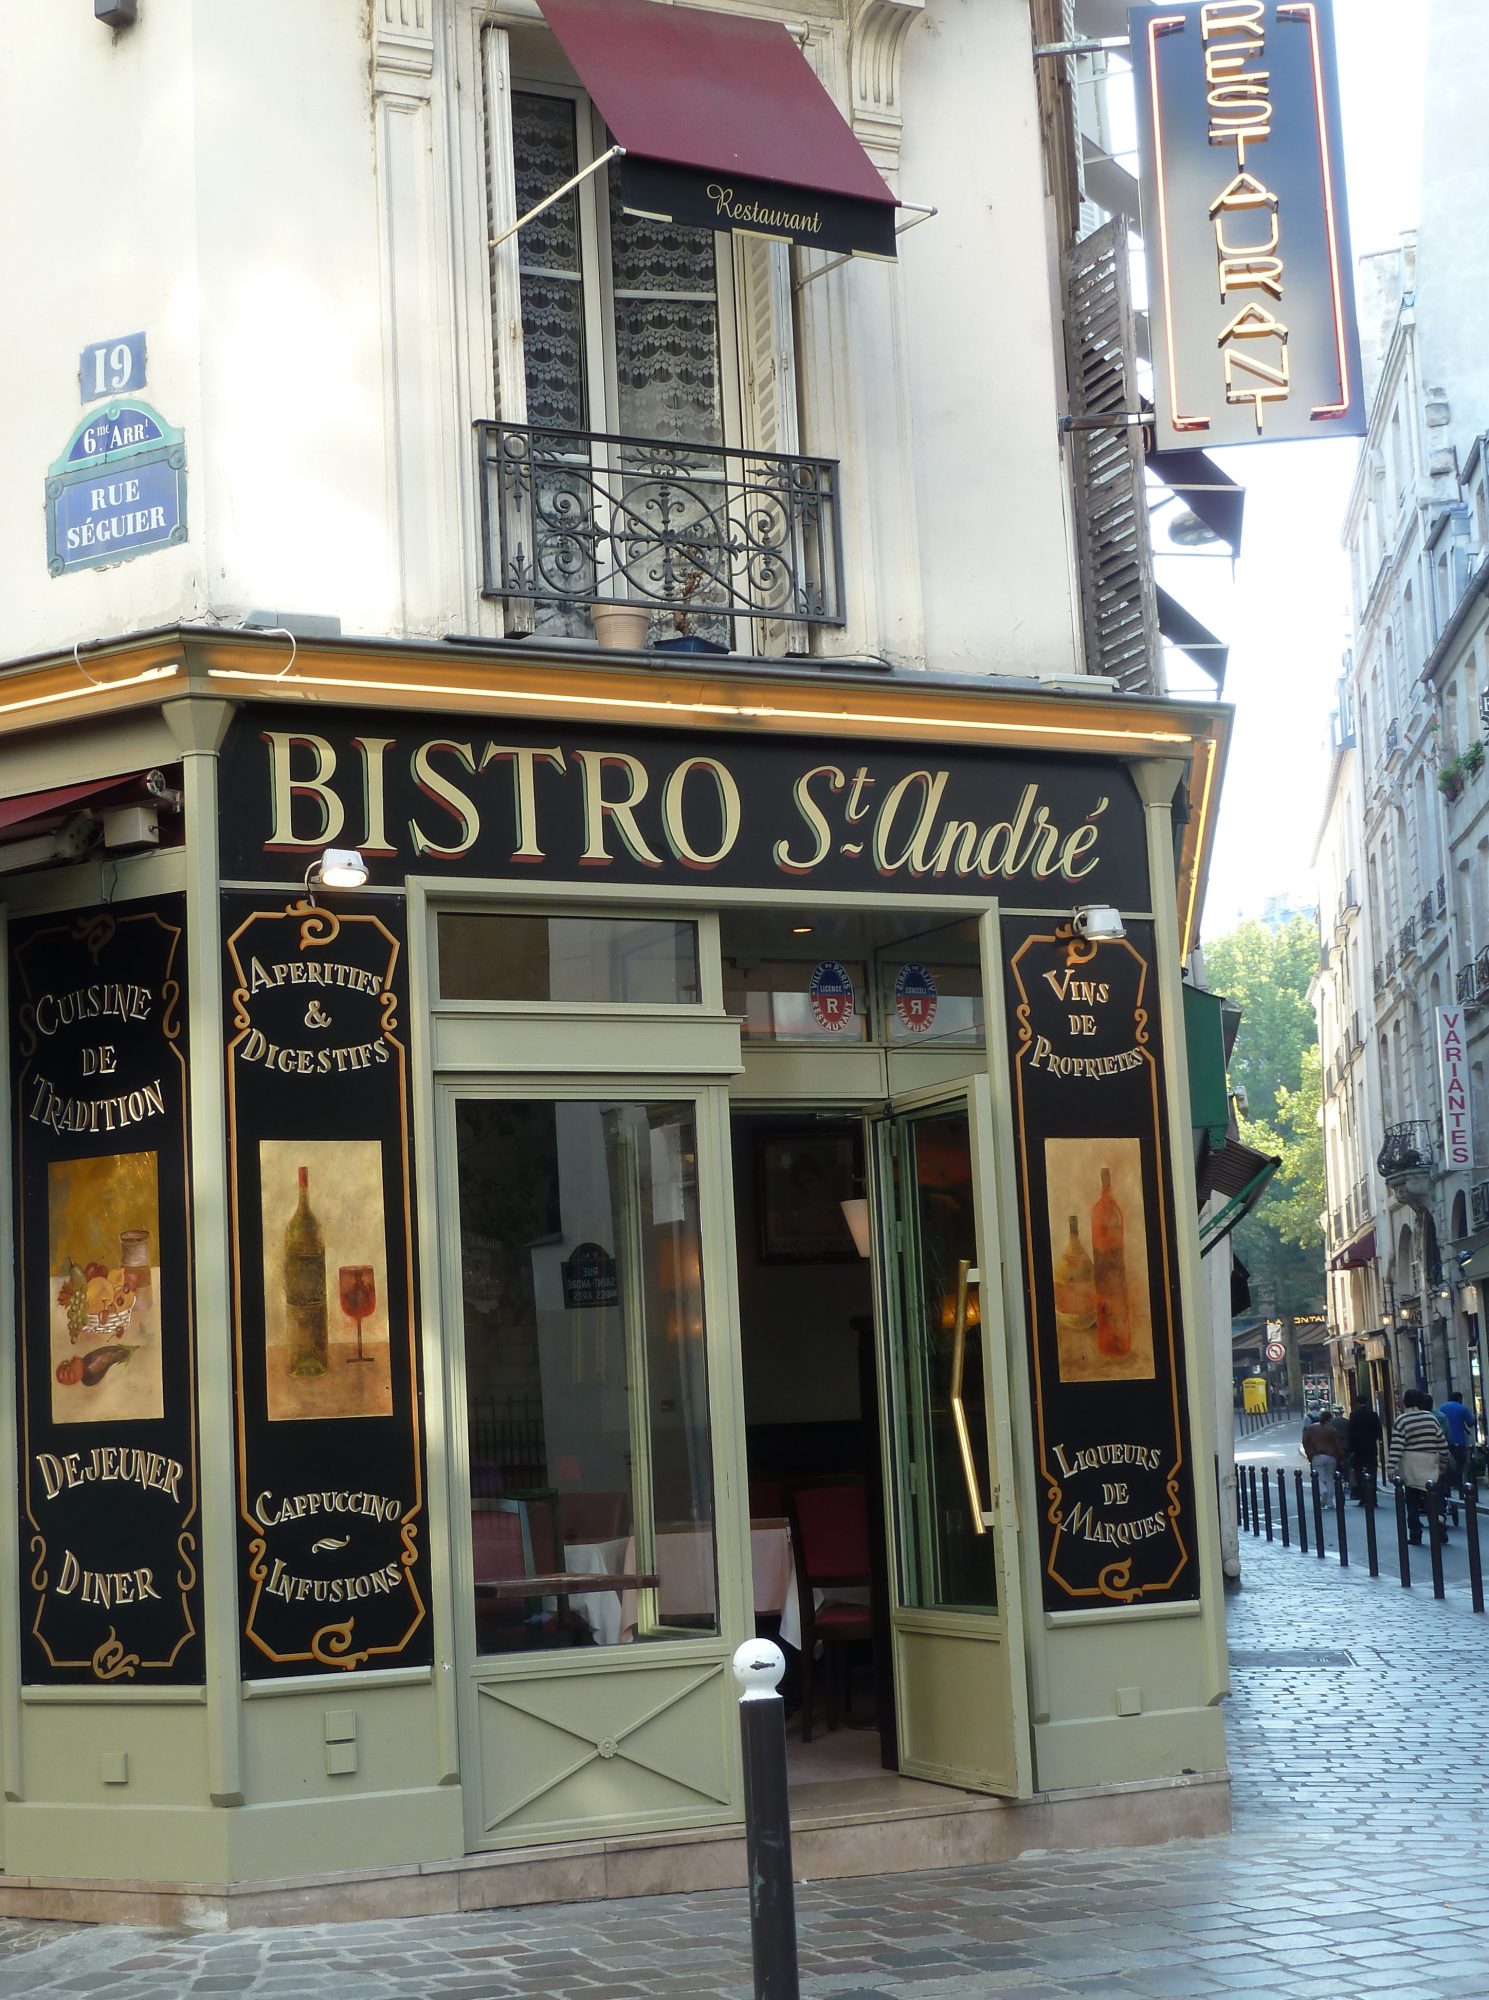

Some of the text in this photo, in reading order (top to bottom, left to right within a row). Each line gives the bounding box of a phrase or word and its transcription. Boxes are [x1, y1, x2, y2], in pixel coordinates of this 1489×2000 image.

[706, 183, 823, 234] Restaurant
[1200, 0, 1289, 428] RESTAURANT
[94, 344, 133, 394] 19
[91, 479, 139, 512] RUE
[67, 505, 167, 550] SÉGUIER
[259, 731, 742, 871] BISTRO
[873, 771, 1110, 883] André
[251, 956, 384, 995] APERITIFS
[811, 965, 825, 989] VILLE
[833, 964, 851, 990] PARIS
[820, 985, 842, 993] LICENCE
[1042, 969, 1110, 1006] VINS
[36, 984, 152, 1035] CUISINE
[304, 1000, 332, 1028] &
[811, 1001, 854, 1031] RESTAURANT
[826, 998, 839, 1014] R
[1068, 1014, 1097, 1036] DE
[82, 1045, 117, 1076] DE
[240, 1028, 390, 1074] DIGESTIFS
[1029, 1034, 1143, 1081] PROPRIETES
[30, 1073, 165, 1136] TRADITION
[1443, 1013, 1469, 1164] VARIANTES
[36, 1447, 184, 1504] DEJEUNER
[1052, 1443, 1162, 1479] LIQUEURS
[255, 1490, 402, 1526] CAPPUCCINO
[1102, 1483, 1130, 1505] DE
[1060, 1501, 1167, 1549] MARQUES
[56, 1549, 162, 1610] DINER
[265, 1558, 403, 1603] INFUSIONS
